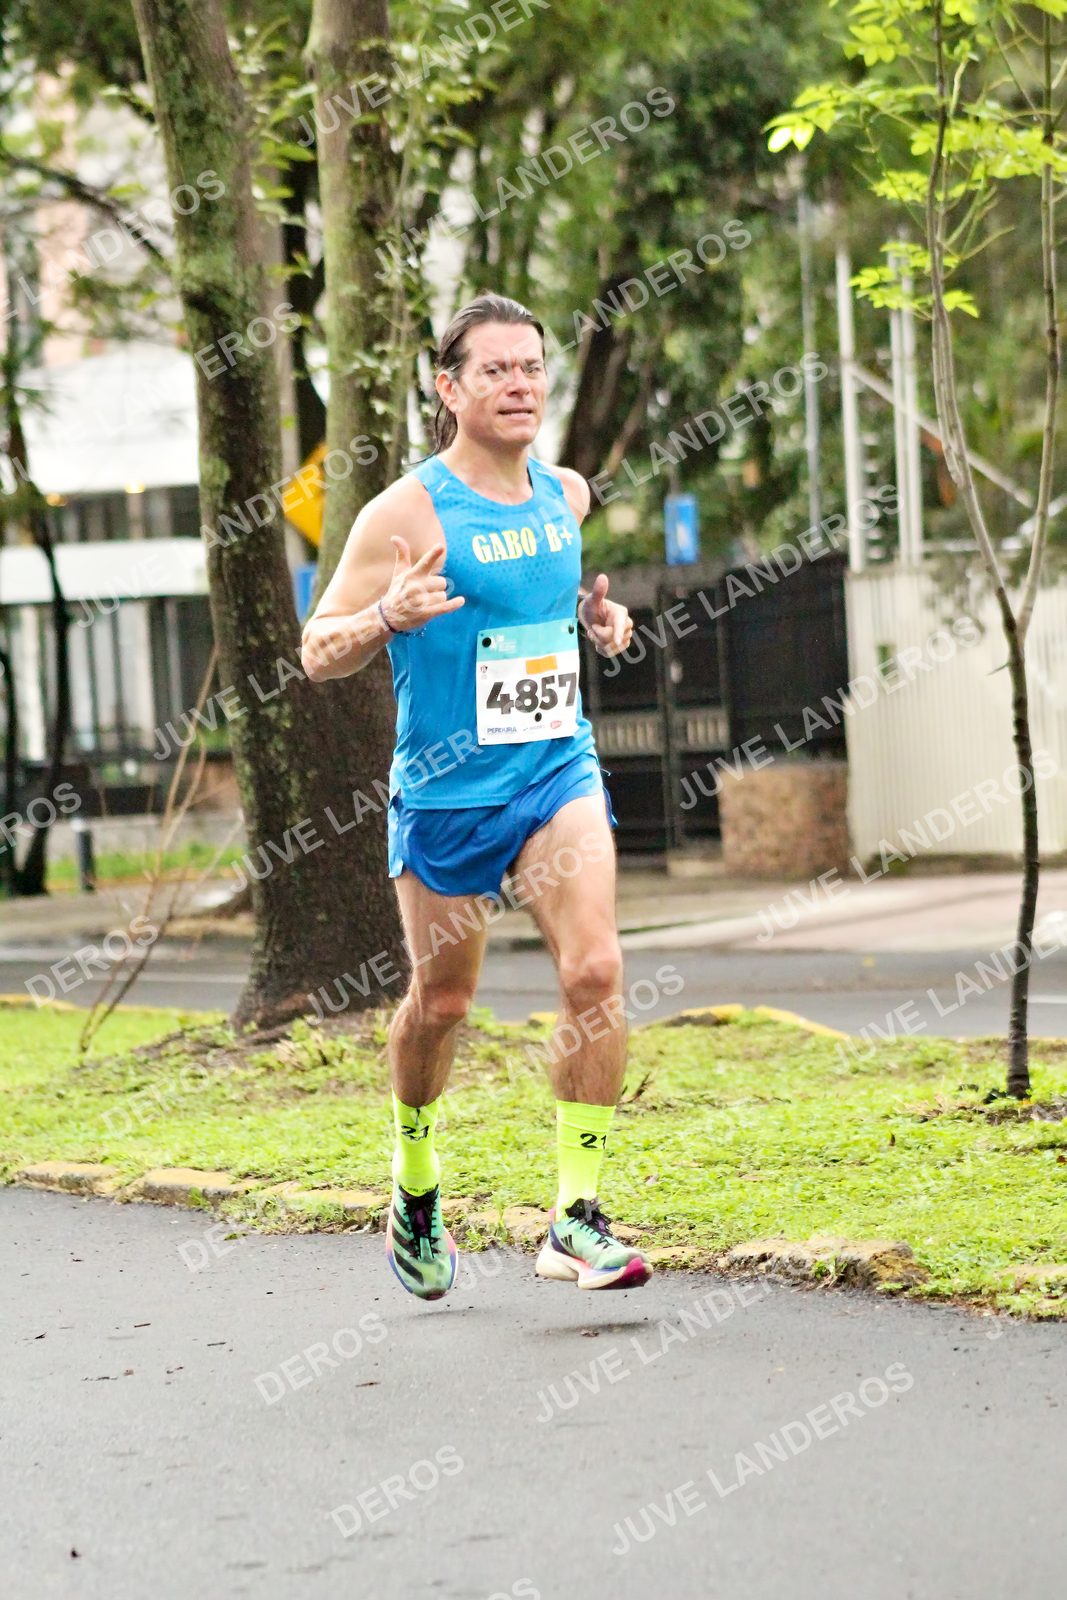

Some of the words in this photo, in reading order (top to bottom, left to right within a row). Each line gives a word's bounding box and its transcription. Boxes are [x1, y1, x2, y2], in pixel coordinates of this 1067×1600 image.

[472, 526, 537, 564] GABO
[544, 523, 573, 554] B+
[486, 672, 577, 715] 4857
[580, 1133, 607, 1150] 21
